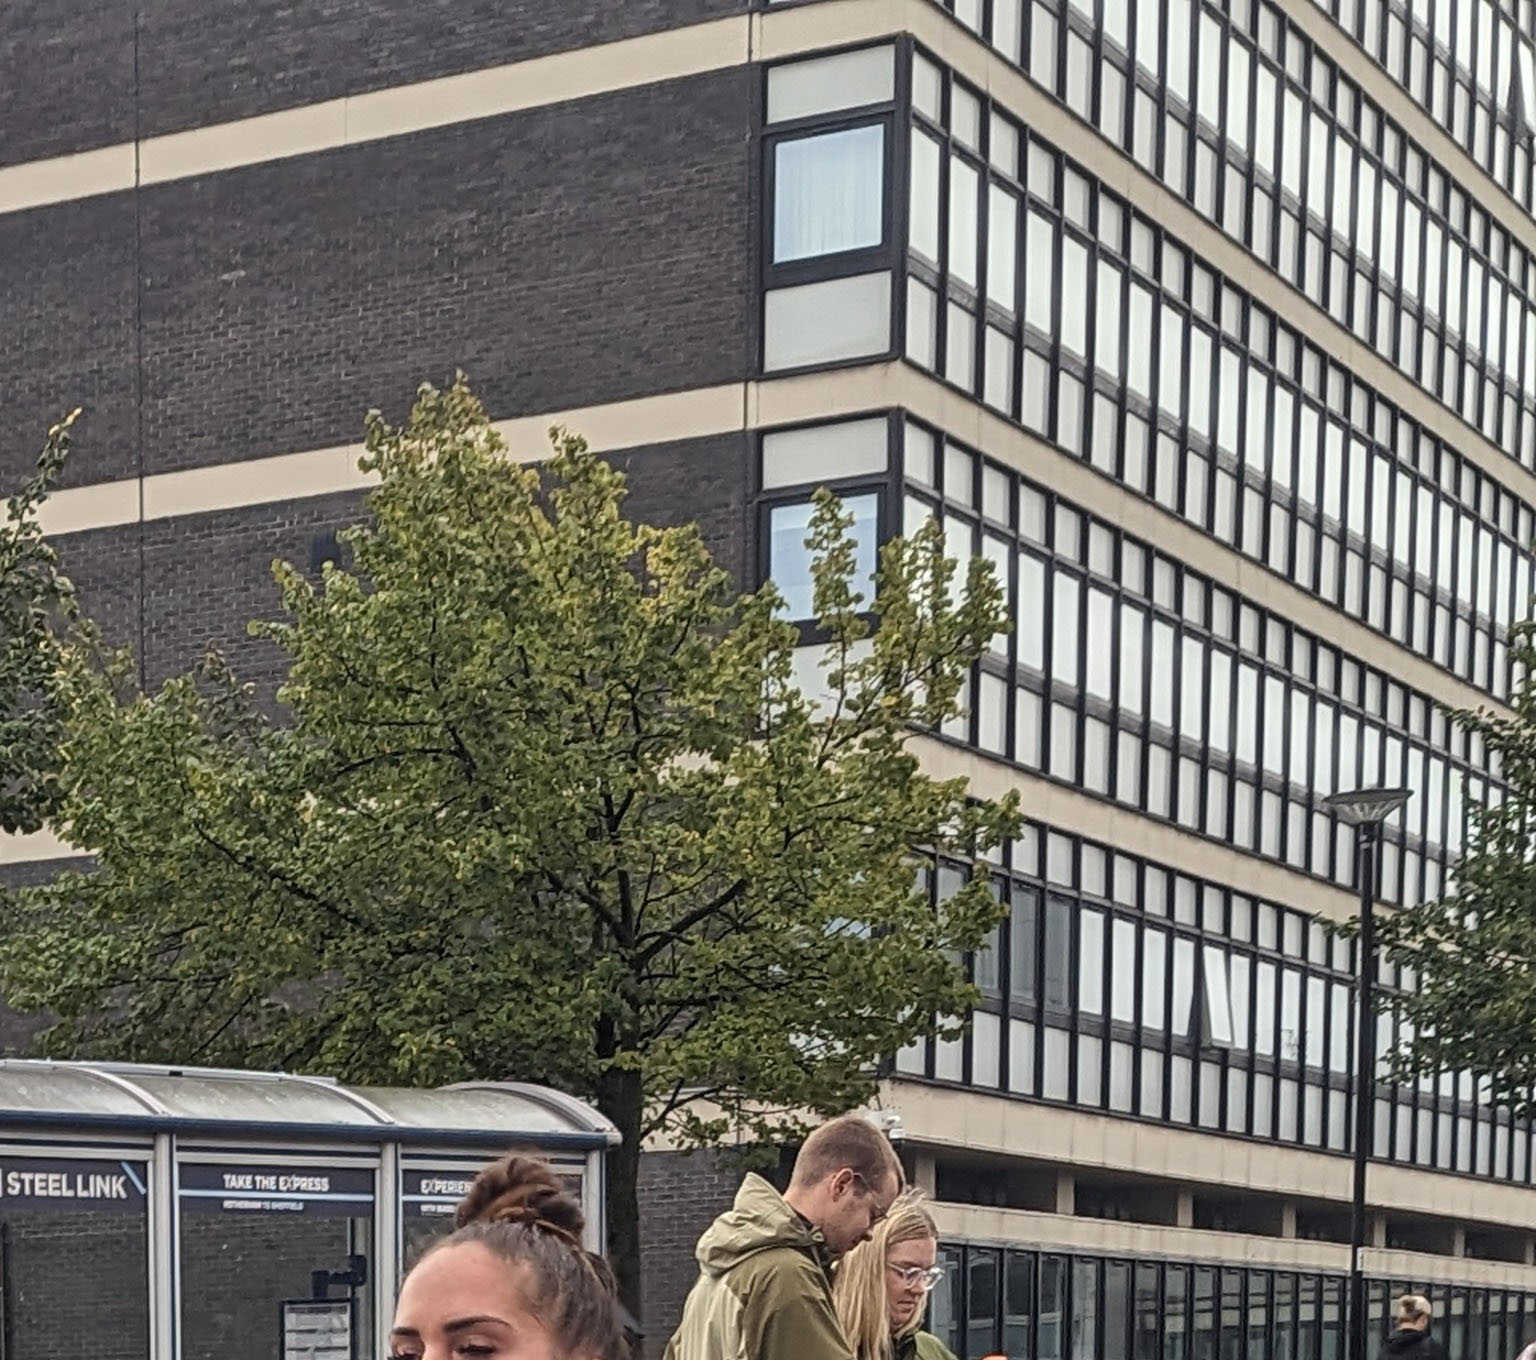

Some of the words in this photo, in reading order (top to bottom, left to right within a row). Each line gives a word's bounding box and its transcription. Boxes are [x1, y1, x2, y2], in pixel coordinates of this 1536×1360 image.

[223, 1174, 253, 1190] TAKE
[254, 1175, 277, 1190] THE
[278, 1173, 330, 1192] EXPRESS
